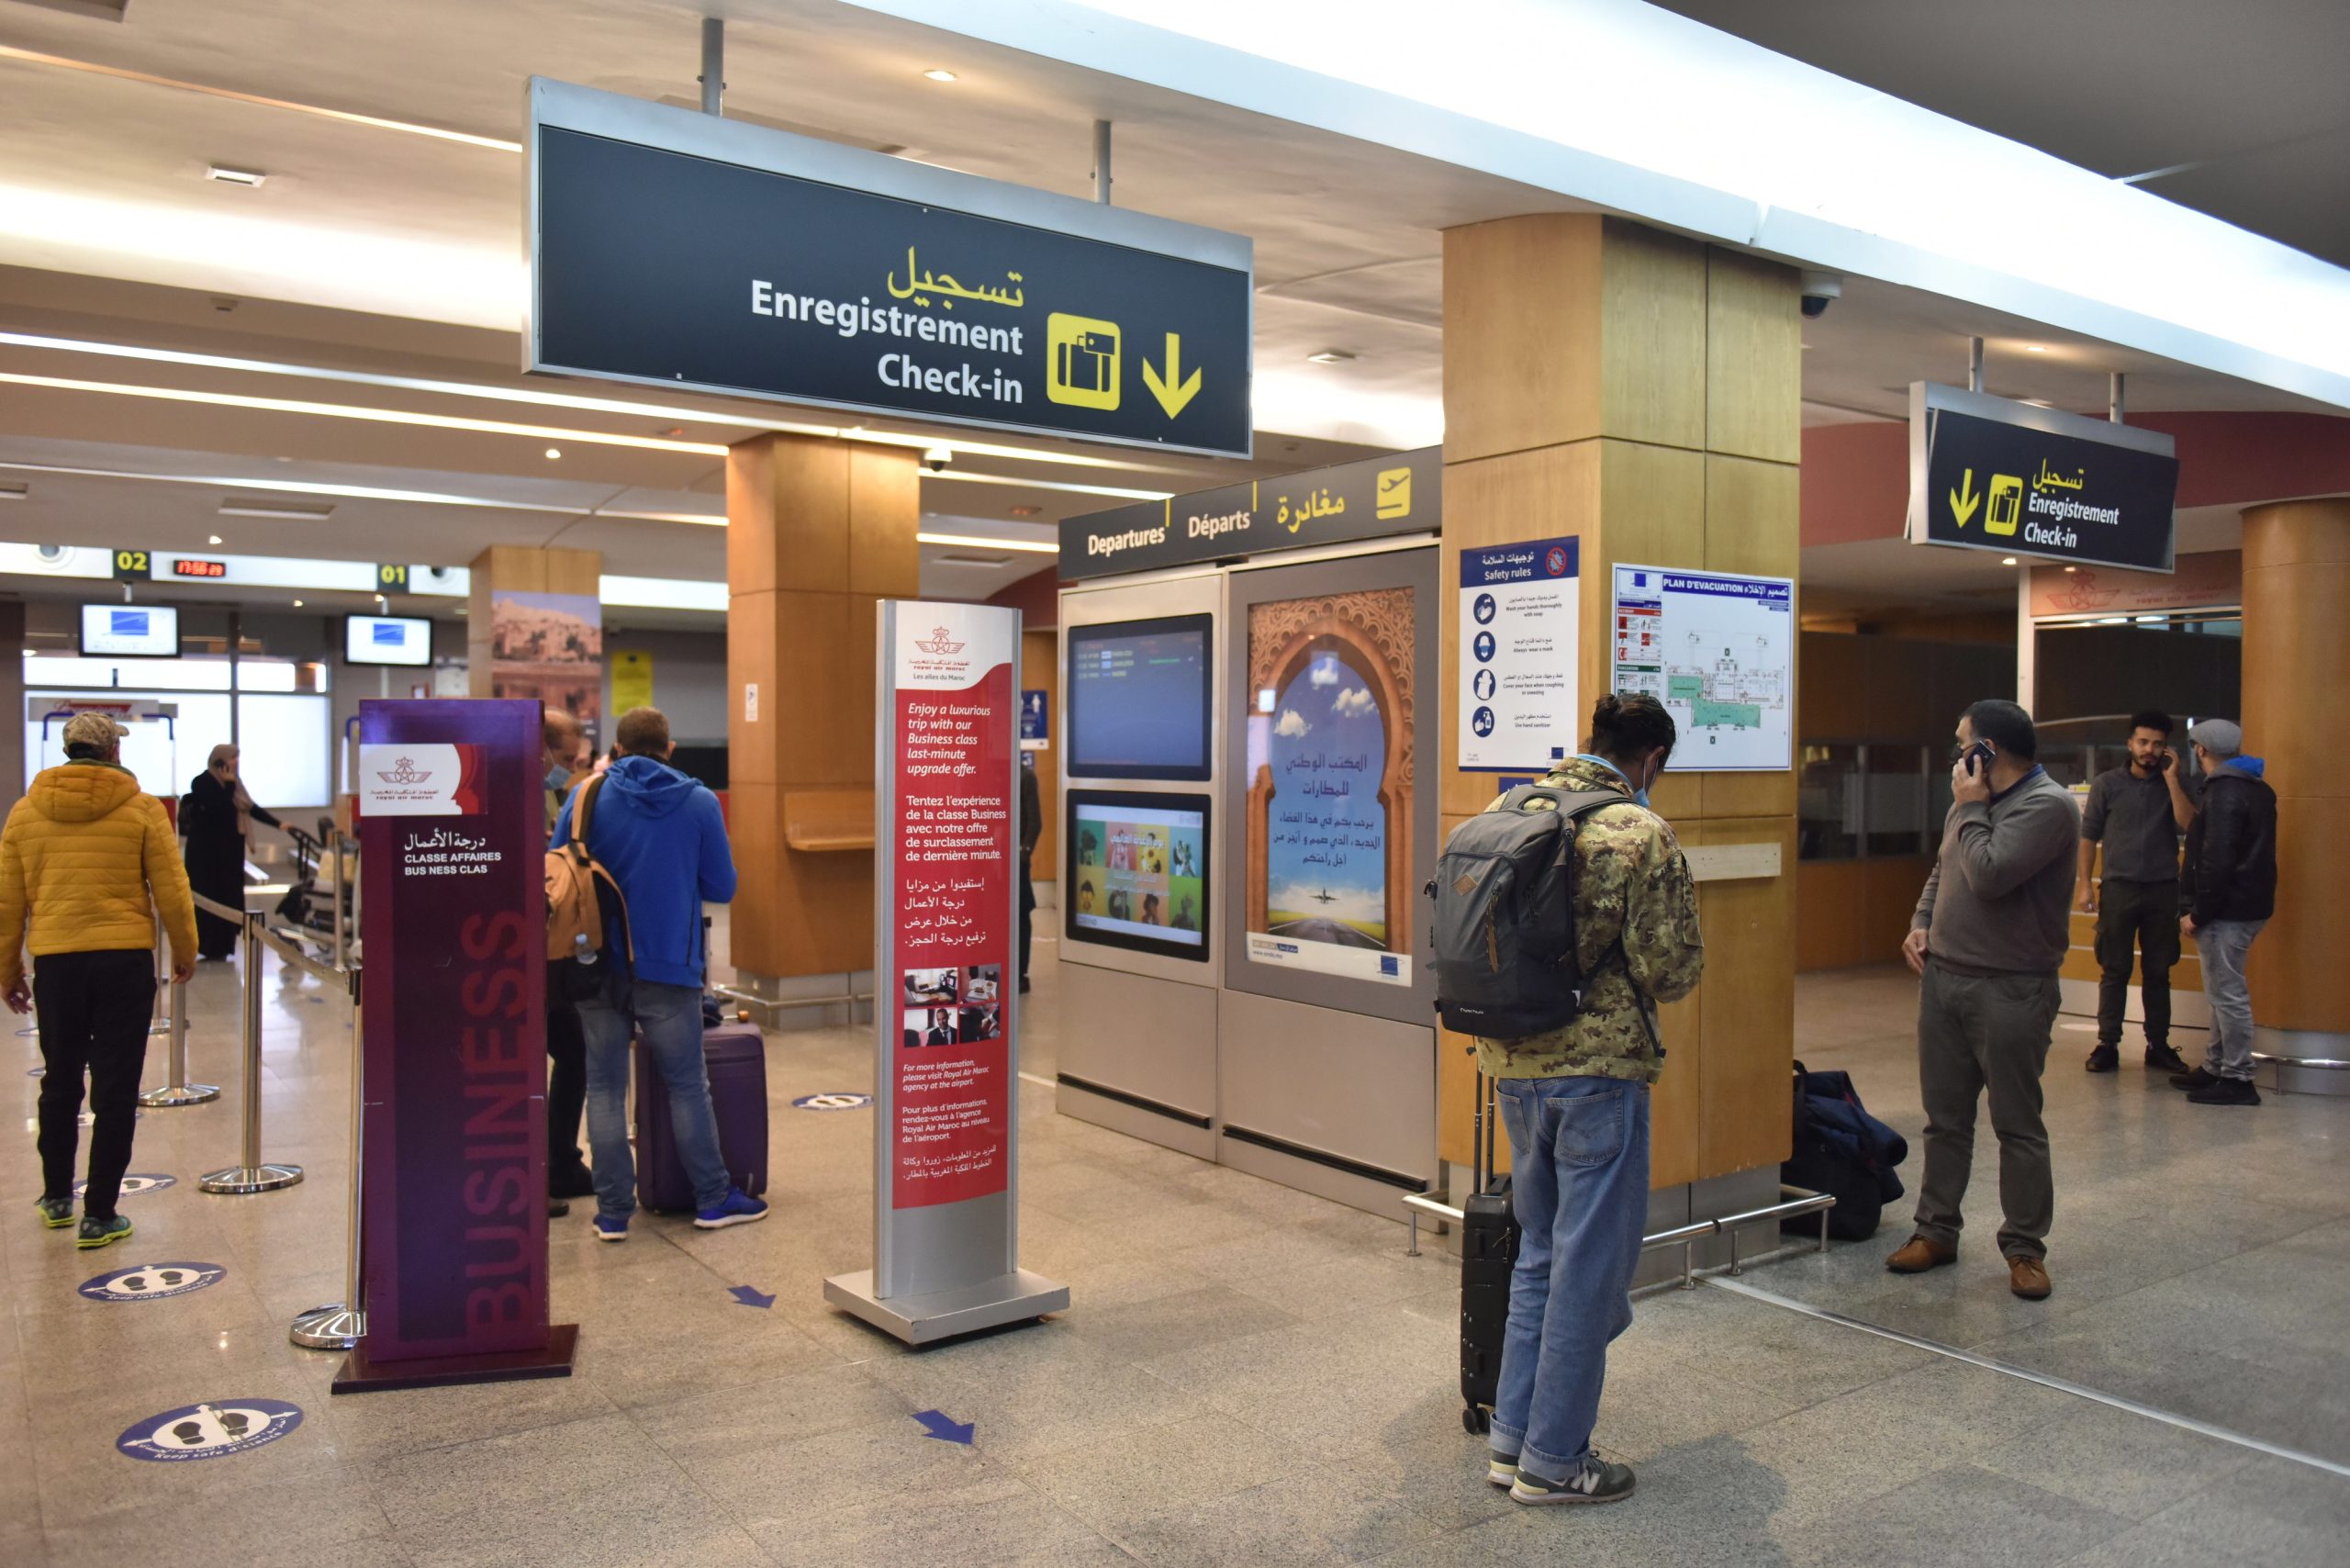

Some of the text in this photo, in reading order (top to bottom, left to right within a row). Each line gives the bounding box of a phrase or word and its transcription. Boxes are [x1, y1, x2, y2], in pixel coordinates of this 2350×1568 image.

[888, 246, 1024, 313] تسجيل
[752, 279, 1024, 355] Enregistrement
[877, 353, 1024, 405] Check-in
[2032, 458, 2085, 495] تسجيل
[1277, 487, 1346, 533] مغادرة
[2028, 492, 2120, 525] Enregistrement
[1188, 510, 1250, 540] Départs
[1088, 525, 1166, 557] Departures
[2024, 522, 2077, 549] Check-in
[118, 552, 147, 570] 02
[1482, 551, 1535, 566] توجيهات السلامة
[381, 565, 406, 584] 01
[1484, 567, 1531, 581] Safety rules
[1663, 578, 1743, 593] PLAN D'EVACUATION
[909, 703, 990, 716] Enjoy a luxurious
[908, 719, 972, 732] trip with our
[908, 734, 978, 745] Business class
[907, 748, 966, 759] last-minute
[907, 763, 977, 777] upgrade offer.
[1286, 753, 1367, 775] المكتب الوطني
[1303, 780, 1348, 798] للمطارات
[906, 795, 1001, 808] Tentez l'expérience
[906, 809, 1006, 820] de la classe Business
[1305, 812, 1318, 823] هذا
[1320, 814, 1332, 829] في
[906, 823, 988, 834] avec notre offre
[404, 828, 486, 851] درجة الأعمال
[905, 836, 993, 847] de surclassement
[1310, 836, 1328, 845] صمم
[405, 852, 502, 864] CLASSE AFFAIRES
[905, 850, 1002, 861] de dernière minute.
[906, 879, 930, 892] مزايا
[932, 881, 946, 891] من
[904, 896, 965, 910] درجة الأعمال
[904, 915, 972, 929] من خلال عرض
[941, 934, 964, 946] درجة
[966, 932, 987, 946] ترفيع
[903, 1064, 915, 1072] For
[916, 1063, 934, 1071] more
[902, 1073, 926, 1082] please
[944, 1070, 962, 1080] Royal
[902, 1083, 928, 1092] agency
[902, 1106, 921, 1114] Pour
[923, 1105, 938, 1114] plus
[902, 1115, 948, 1124] rendez-vous
[956, 1109, 981, 1120] l'agence
[462, 908, 532, 1333] BUSINESS
[902, 1125, 923, 1134] Royal
[925, 1124, 935, 1132] Air
[937, 1122, 960, 1130] Maroc
[971, 1117, 990, 1126] niveau
[164, 1282, 209, 1296] distance
[193, 1449, 224, 1458] safe
[229, 1430, 283, 1453] distance
